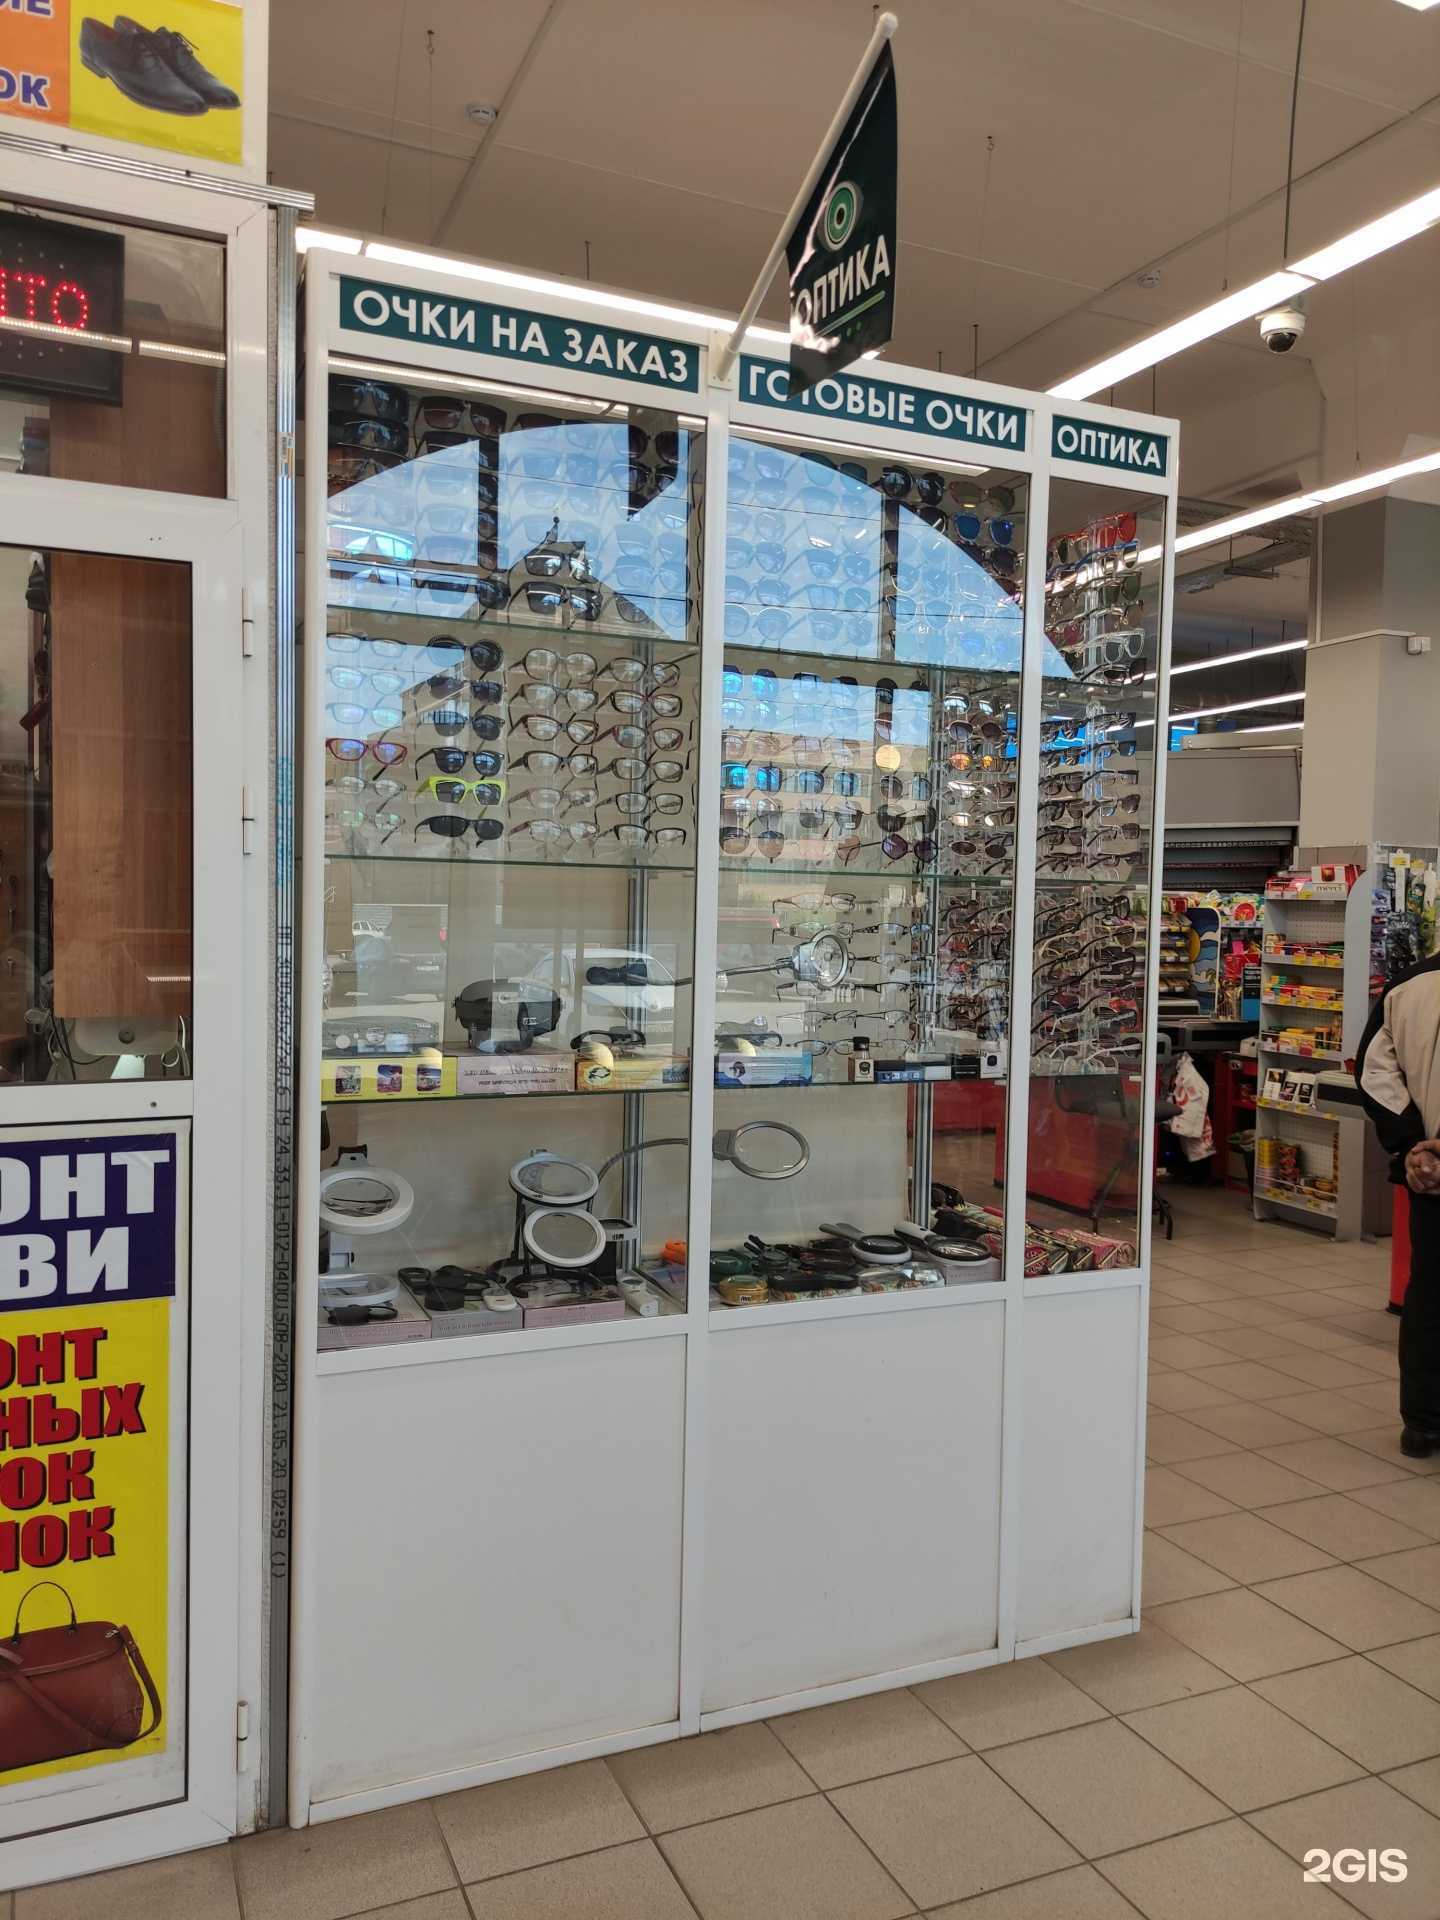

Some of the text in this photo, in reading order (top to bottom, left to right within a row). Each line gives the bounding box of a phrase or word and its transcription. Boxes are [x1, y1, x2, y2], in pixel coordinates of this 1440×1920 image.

[795, 234, 891, 327] ОПТИКА
[353, 289, 688, 383] ОЧКИ НА ЗАКАЗ
[926, 398, 1018, 443] ОЧКИ
[1056, 424, 1162, 469] ОПТИКА
[272, 1401, 288, 1479] 21.05.20
[271, 1488, 287, 1539] 02:59
